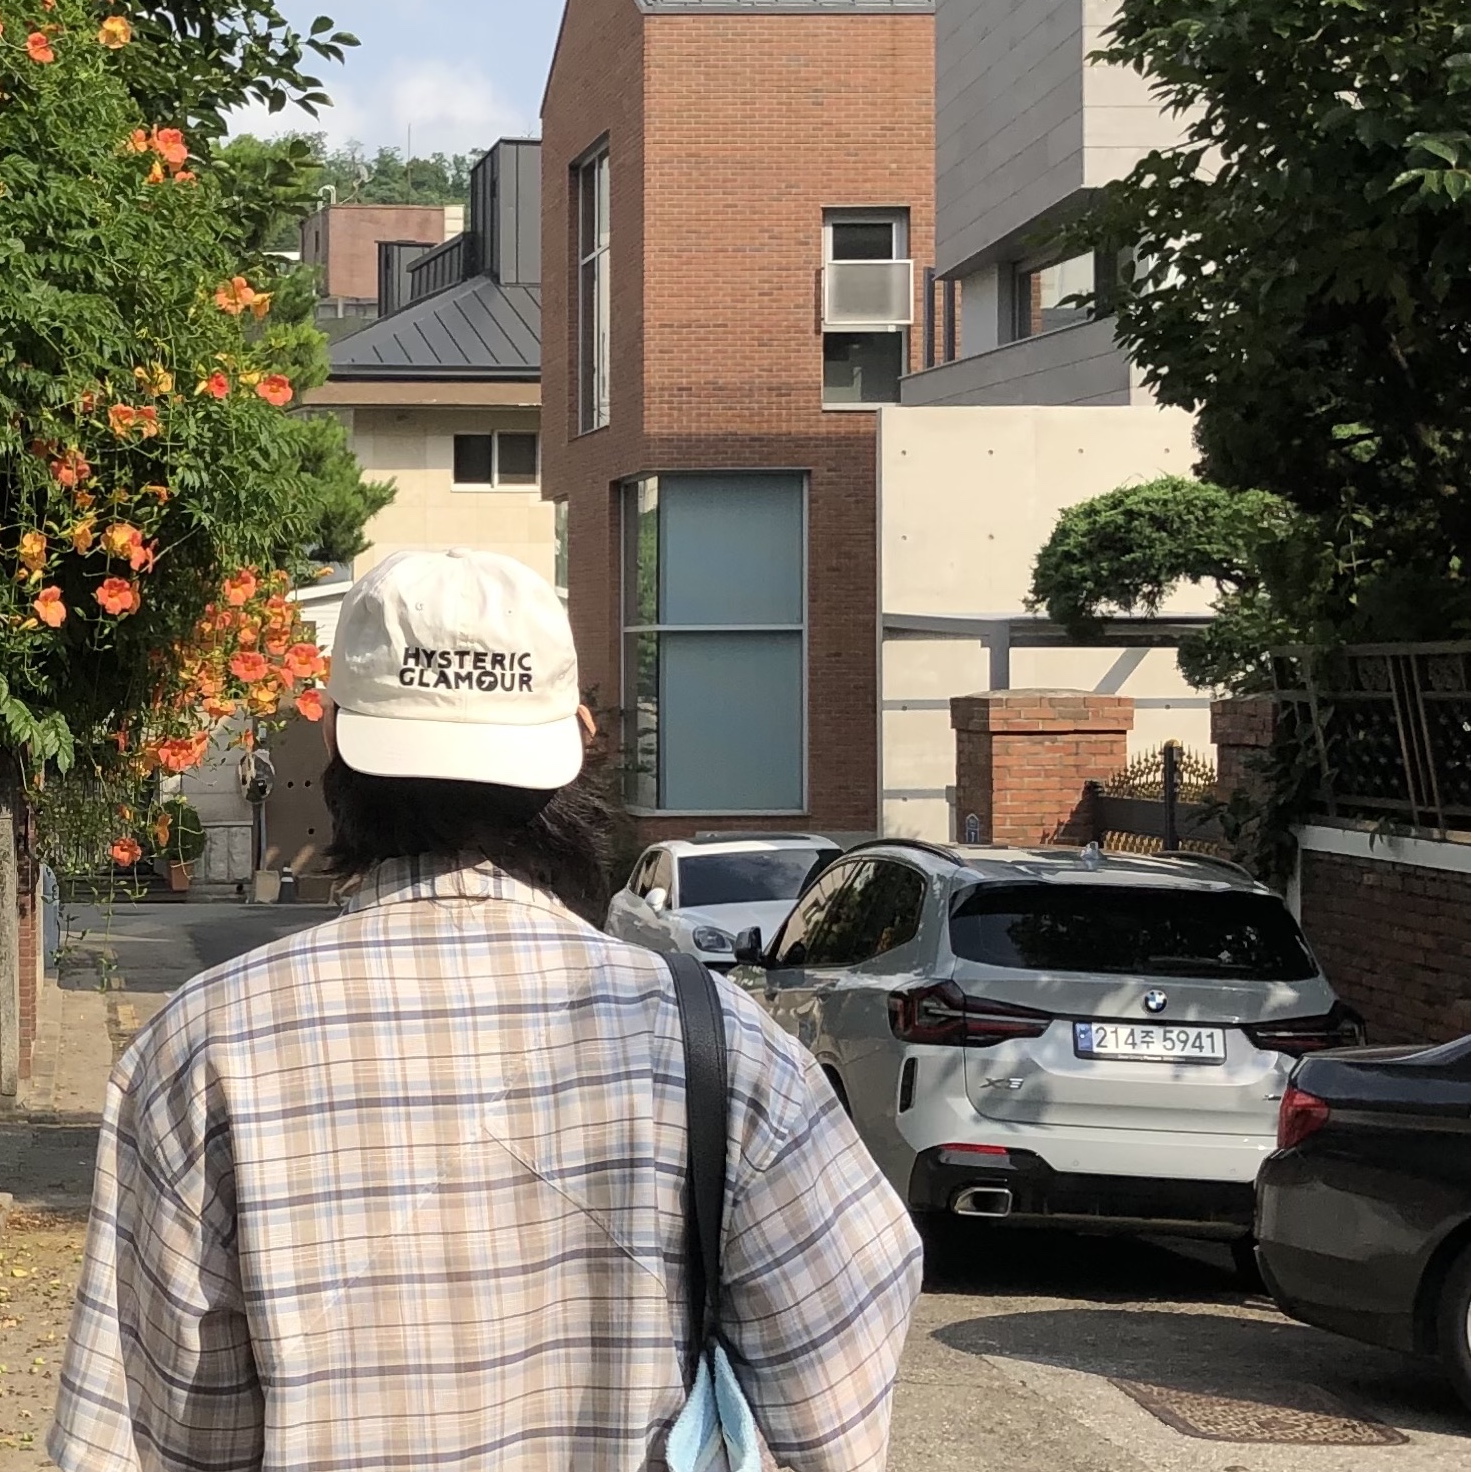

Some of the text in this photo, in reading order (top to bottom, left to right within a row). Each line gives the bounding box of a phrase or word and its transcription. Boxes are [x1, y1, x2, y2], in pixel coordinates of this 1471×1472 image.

[402, 646, 532, 671] HYSTERIC
[399, 668, 533, 692] GLAMOUR
[1094, 1026, 1216, 1054] 214주 5941
